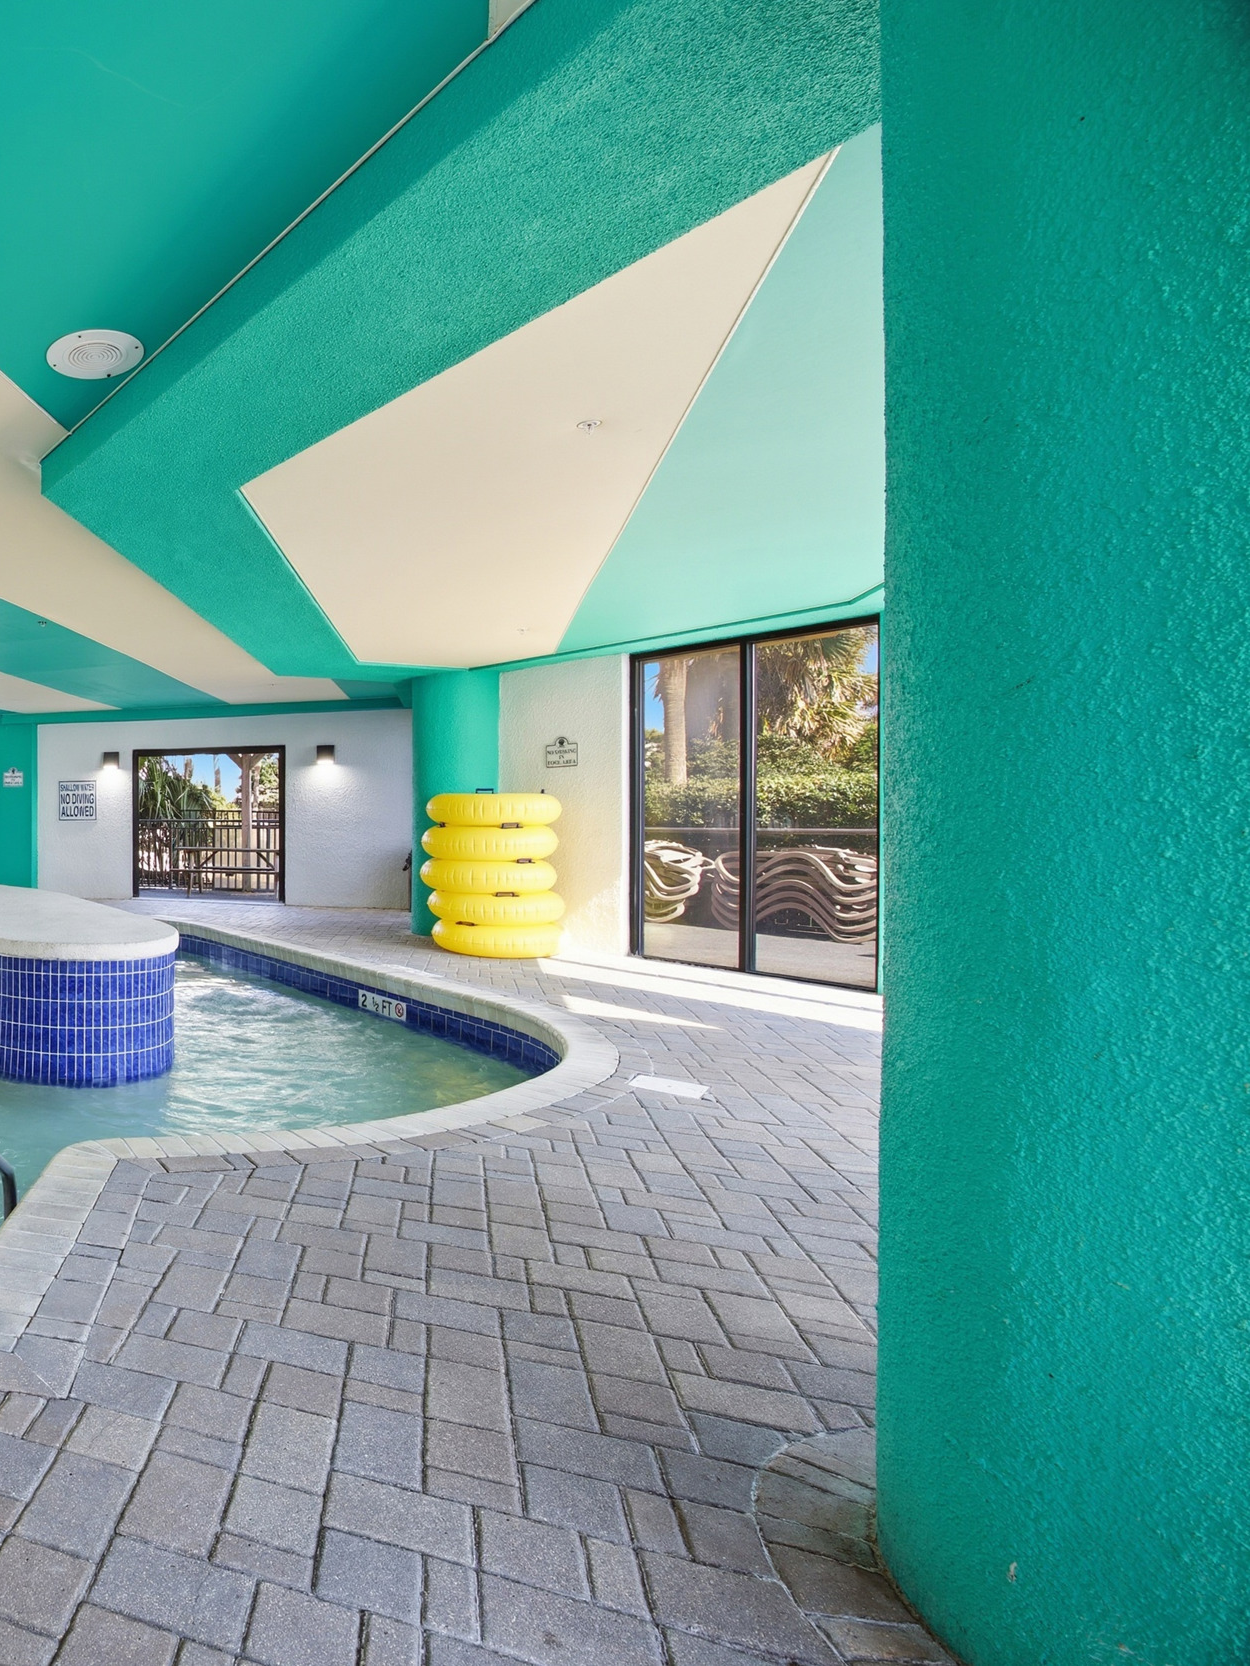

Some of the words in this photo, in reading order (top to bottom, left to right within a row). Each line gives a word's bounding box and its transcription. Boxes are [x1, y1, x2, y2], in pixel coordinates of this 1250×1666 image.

[60, 793, 71, 805] NO
[71, 793, 95, 805] DIVING
[60, 805, 95, 818] ALLOWED
[361, 993, 368, 1008] 2
[381, 1000, 393, 1017] FT
